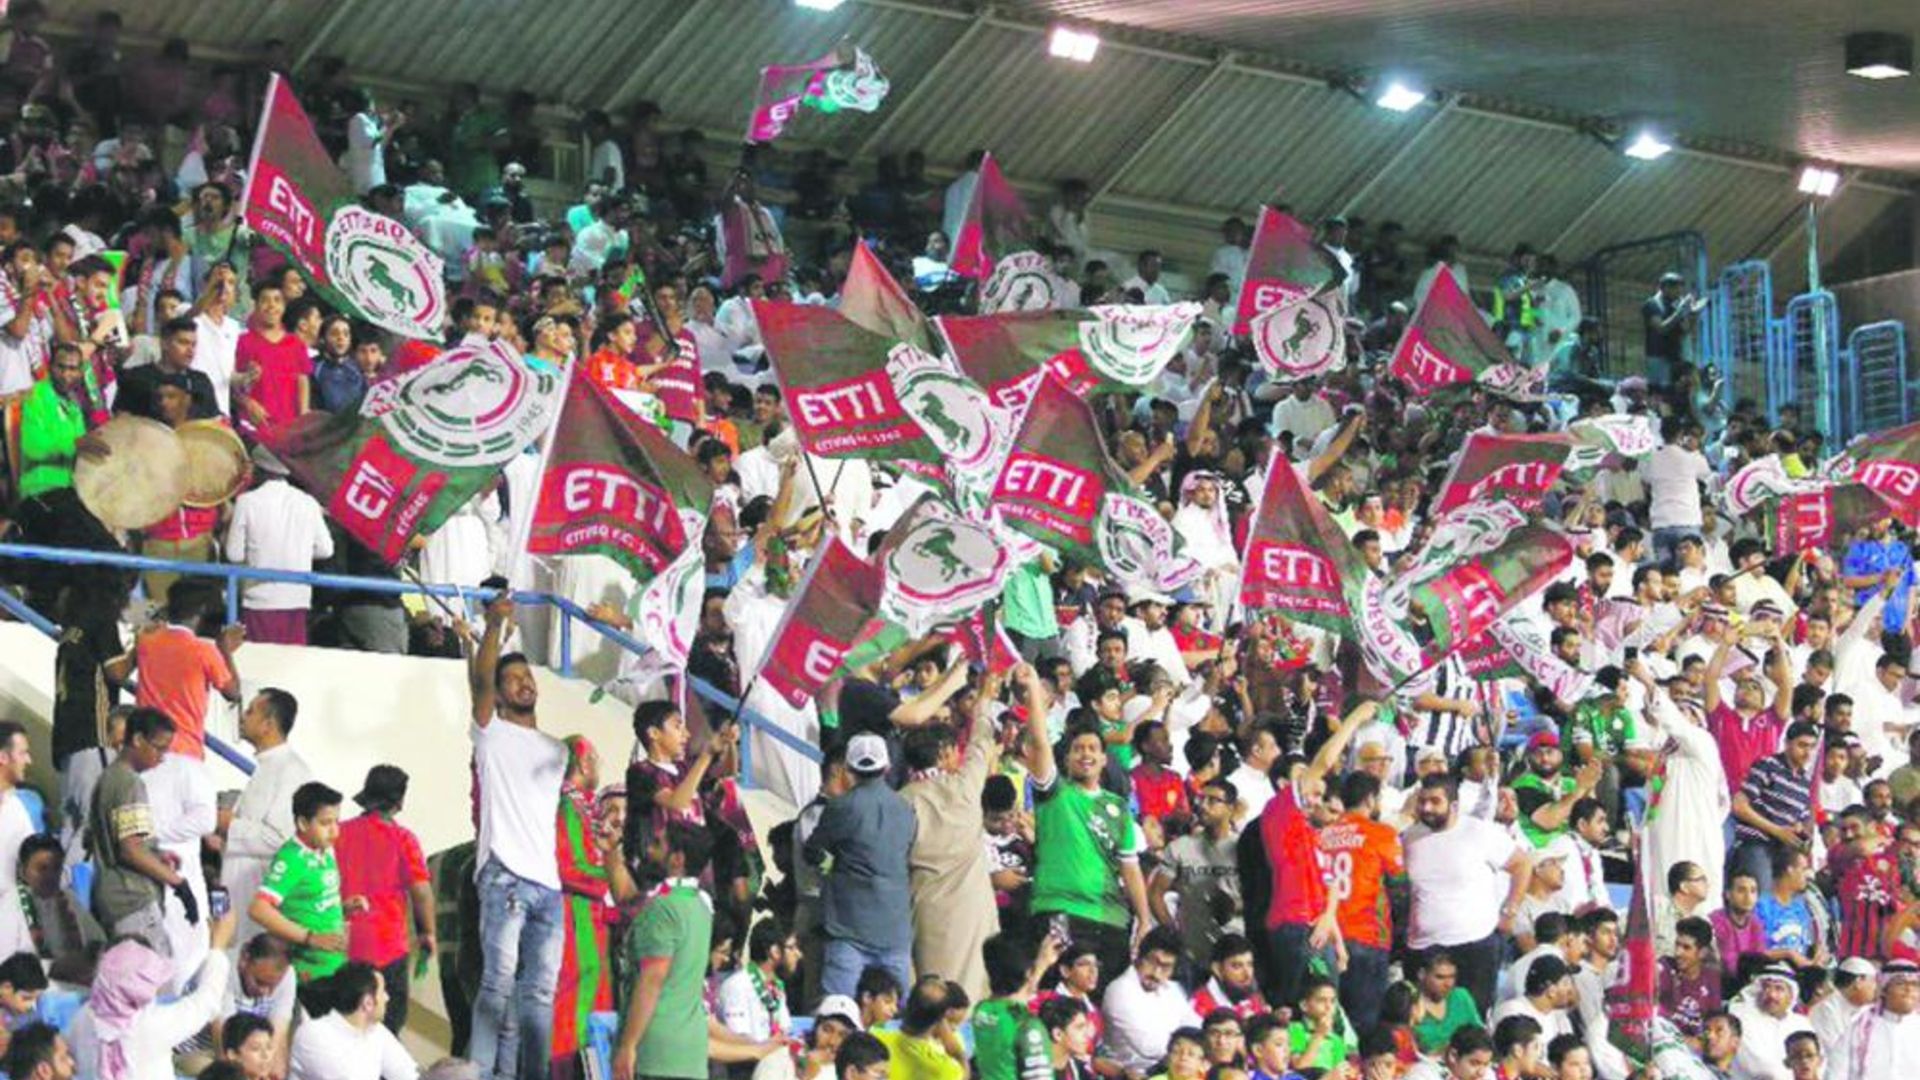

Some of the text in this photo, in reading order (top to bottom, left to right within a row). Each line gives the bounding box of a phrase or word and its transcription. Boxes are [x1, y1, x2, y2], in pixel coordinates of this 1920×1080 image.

[269, 175, 314, 245] ETTI
[1411, 340, 1457, 383] ETTI
[796, 381, 886, 427] ETTI
[563, 468, 669, 533] ETTI
[1003, 458, 1086, 508] ETTI
[1263, 547, 1336, 588] ETTI
